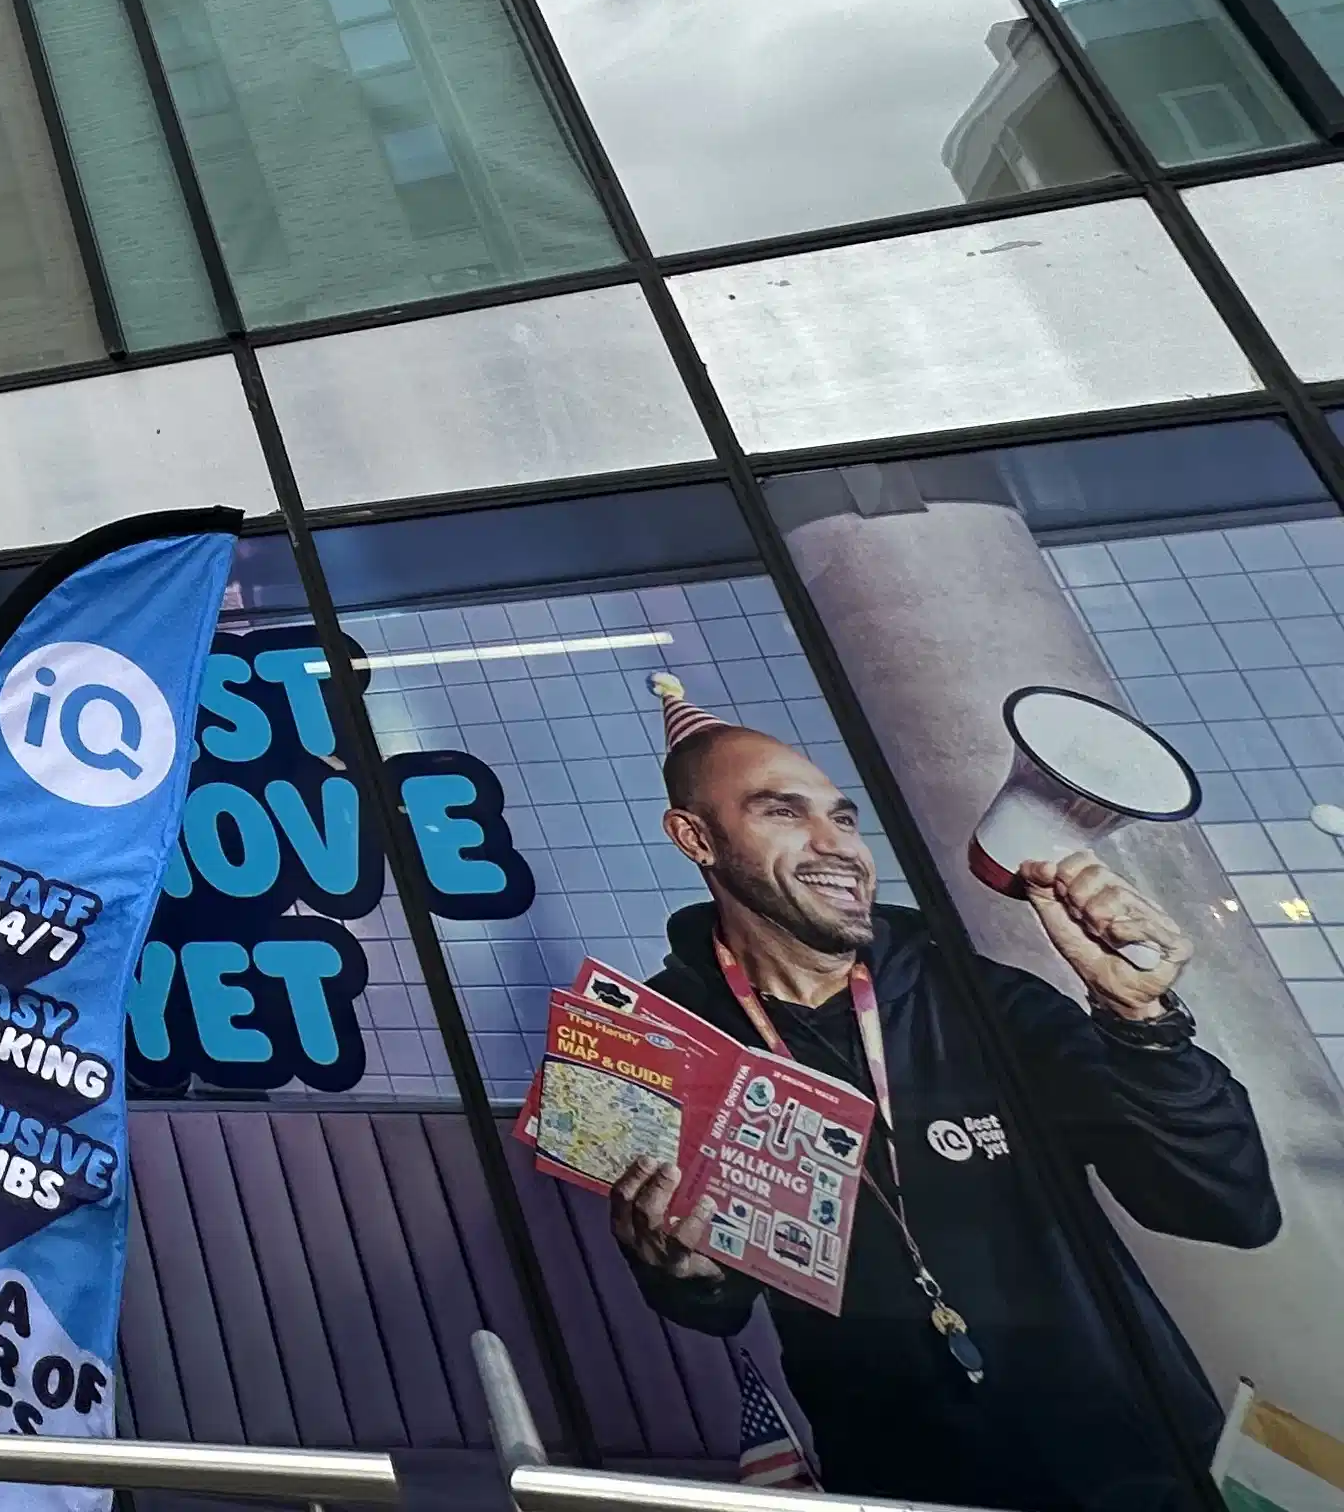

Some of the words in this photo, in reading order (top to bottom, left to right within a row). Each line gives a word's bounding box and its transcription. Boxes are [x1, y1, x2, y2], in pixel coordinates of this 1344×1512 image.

[24, 666, 143, 781] iQ
[194, 648, 336, 762] ST
[162, 774, 507, 898] OVE
[126, 941, 342, 1065] YET
[568, 1012, 593, 1029] The
[596, 1020, 640, 1046] Handy
[557, 1026, 599, 1048] CITY
[558, 1038, 600, 1062] MAP
[601, 1055, 614, 1070] &
[616, 1060, 674, 1090] GUIDE
[719, 1161, 772, 1199] TOUR
[720, 1144, 807, 1194] WALKING
[32, 1355, 107, 1414] OF
